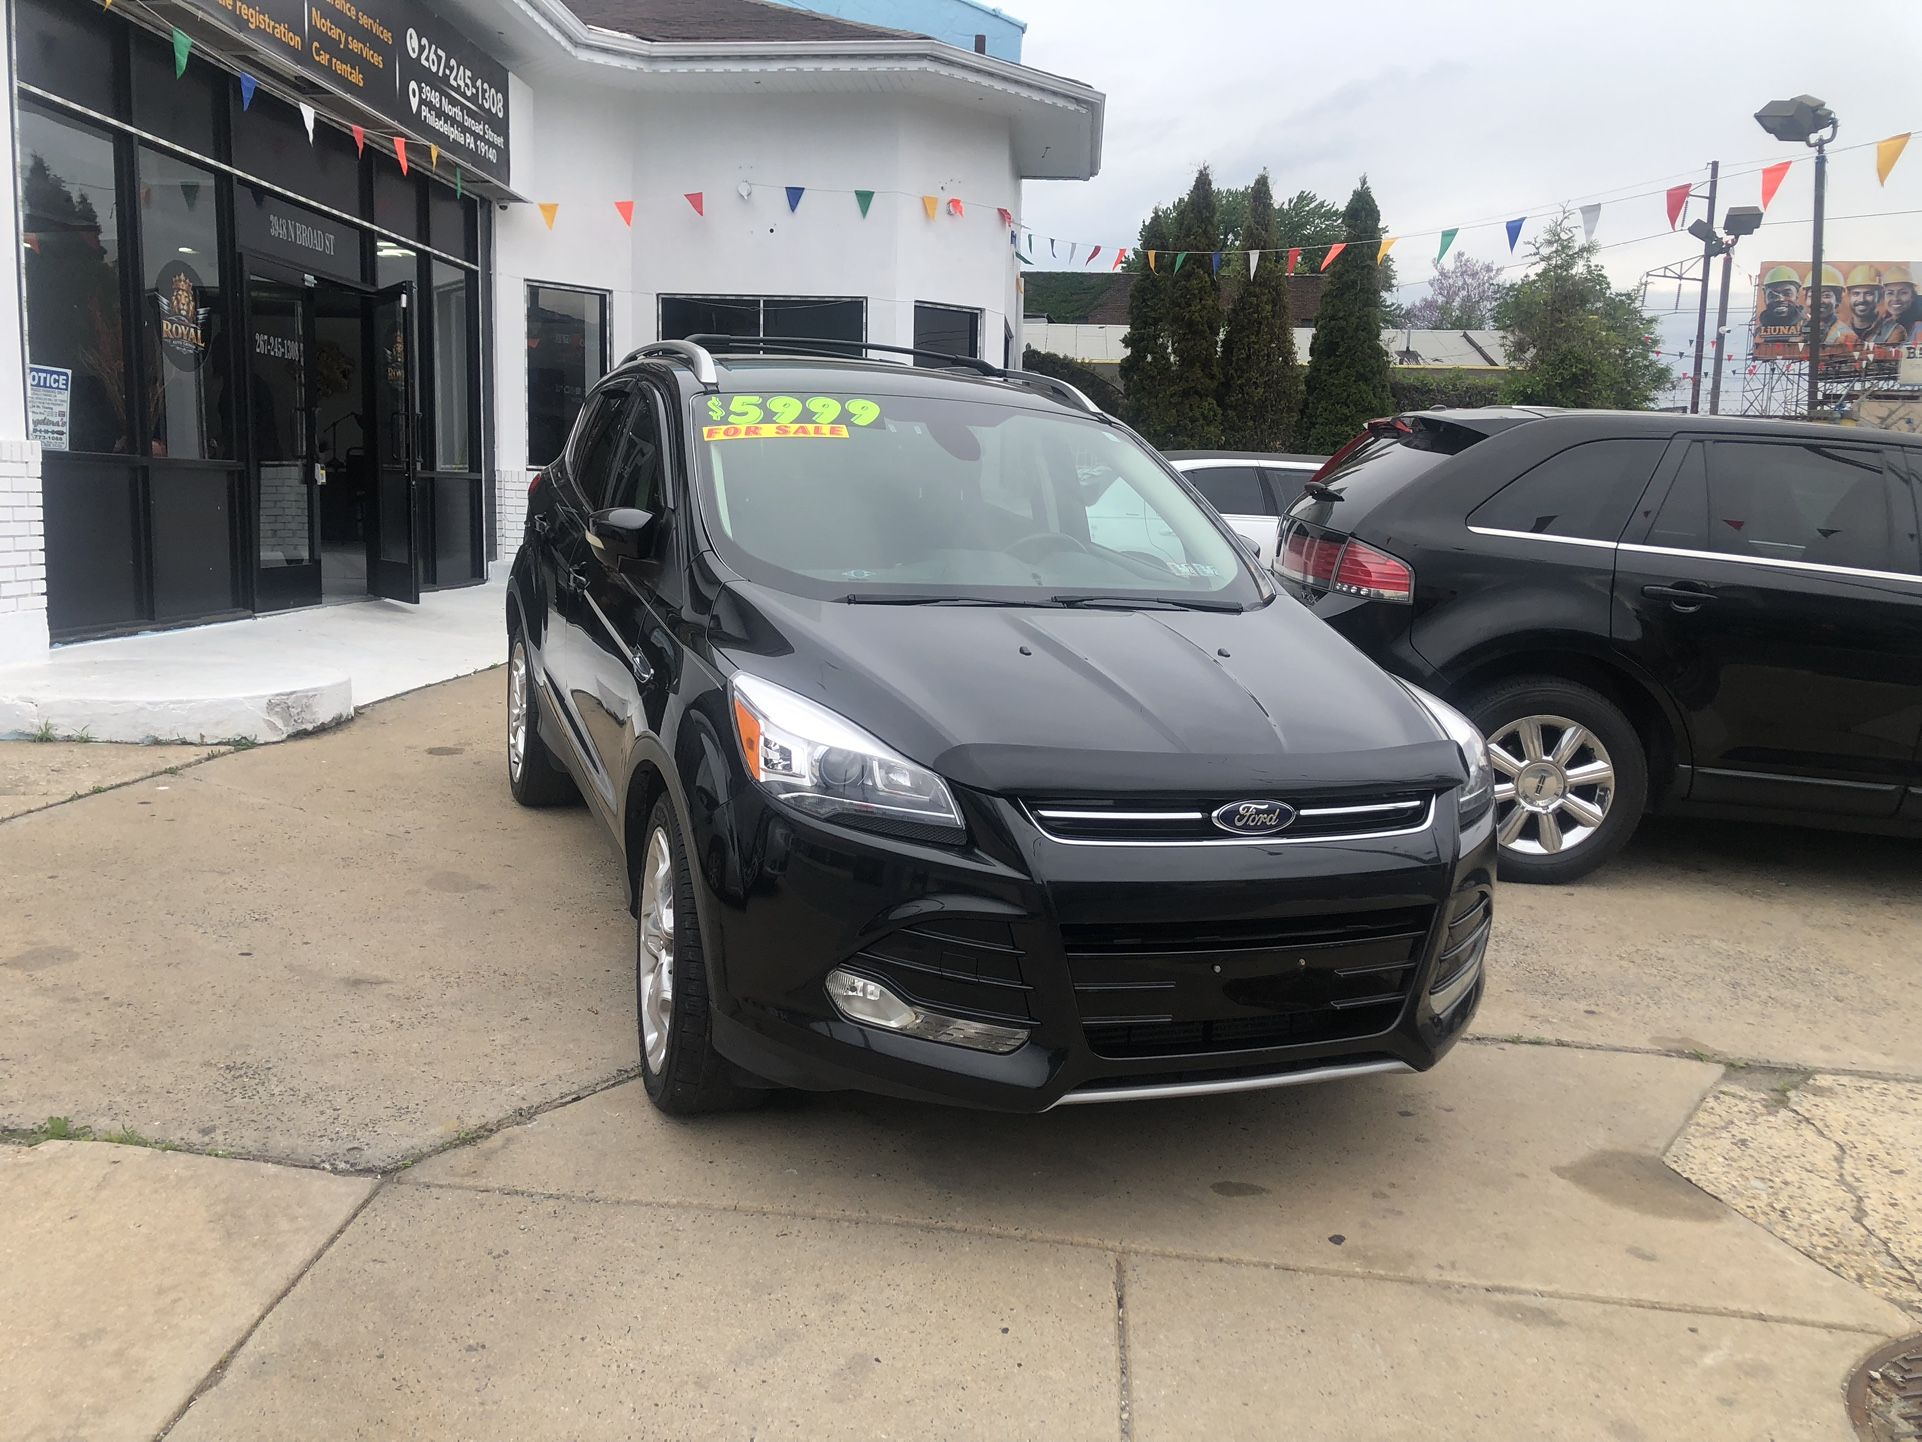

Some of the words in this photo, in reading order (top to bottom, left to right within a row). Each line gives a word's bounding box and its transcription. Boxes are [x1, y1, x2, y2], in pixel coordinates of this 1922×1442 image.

[236, 0, 302, 51] registration
[311, 7, 346, 49] Notary
[347, 35, 384, 69] services
[358, 11, 393, 45] services
[312, 42, 329, 67] Car
[332, 57, 364, 87] rentals
[420, 37, 504, 118] 267-245-1308
[421, 82, 440, 108] 3948
[441, 95, 463, 121] North
[463, 109, 484, 136] broad
[484, 124, 504, 149] Street
[421, 105, 465, 145] Philadelphia
[465, 134, 476, 152] PA
[476, 140, 498, 164] 19140
[269, 214, 287, 240] 3948
[287, 219, 295, 242] N
[295, 222, 324, 252] BROAD
[324, 232, 335, 256] ST
[162, 320, 206, 347] ROYAL
[30, 371, 67, 389] OTICE
[707, 395, 881, 426] $5999
[706, 425, 763, 439] FOR
[774, 425, 845, 436] SALE
[1234, 803, 1280, 827] Ford
